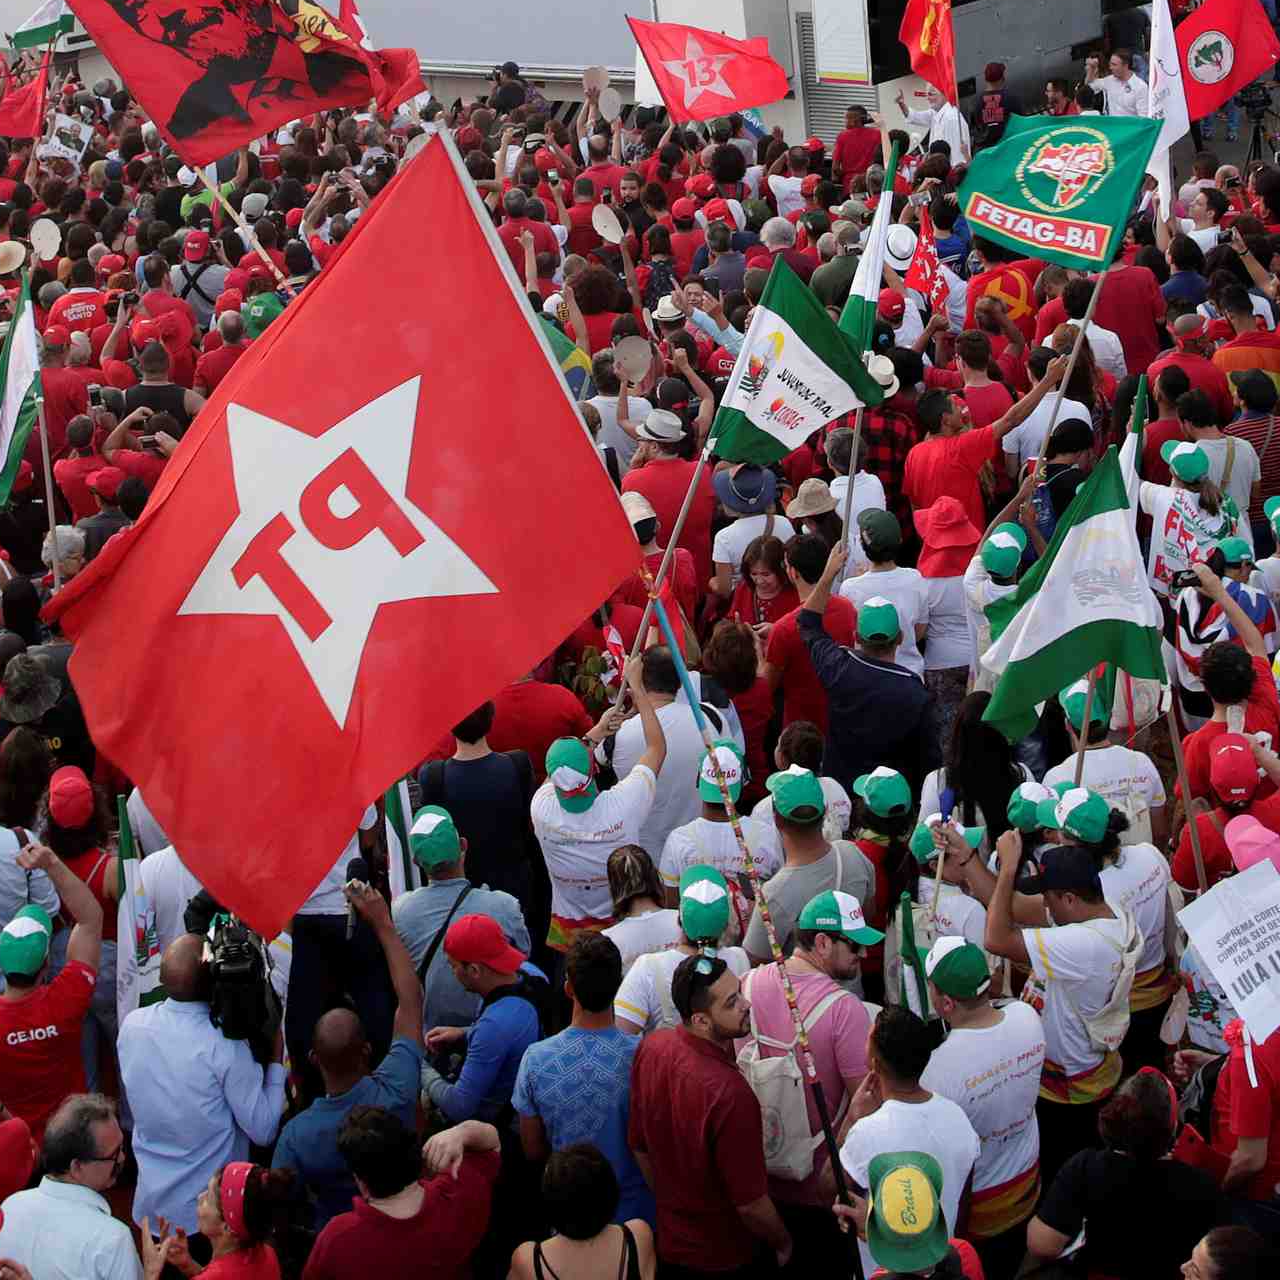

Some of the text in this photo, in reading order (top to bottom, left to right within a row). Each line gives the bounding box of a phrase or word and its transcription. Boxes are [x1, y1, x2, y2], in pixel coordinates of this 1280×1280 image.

[681, 56, 718, 89] 13
[975, 199, 1097, 253] FETAG-BA
[1215, 918, 1255, 949] SUPREMA
[1216, 936, 1251, 965] CUMPRA
[1249, 925, 1271, 942] SEU
[1231, 961, 1272, 1002] LULA
[6, 1024, 60, 1046] CEJOR
[900, 1176, 918, 1228] Brasil
